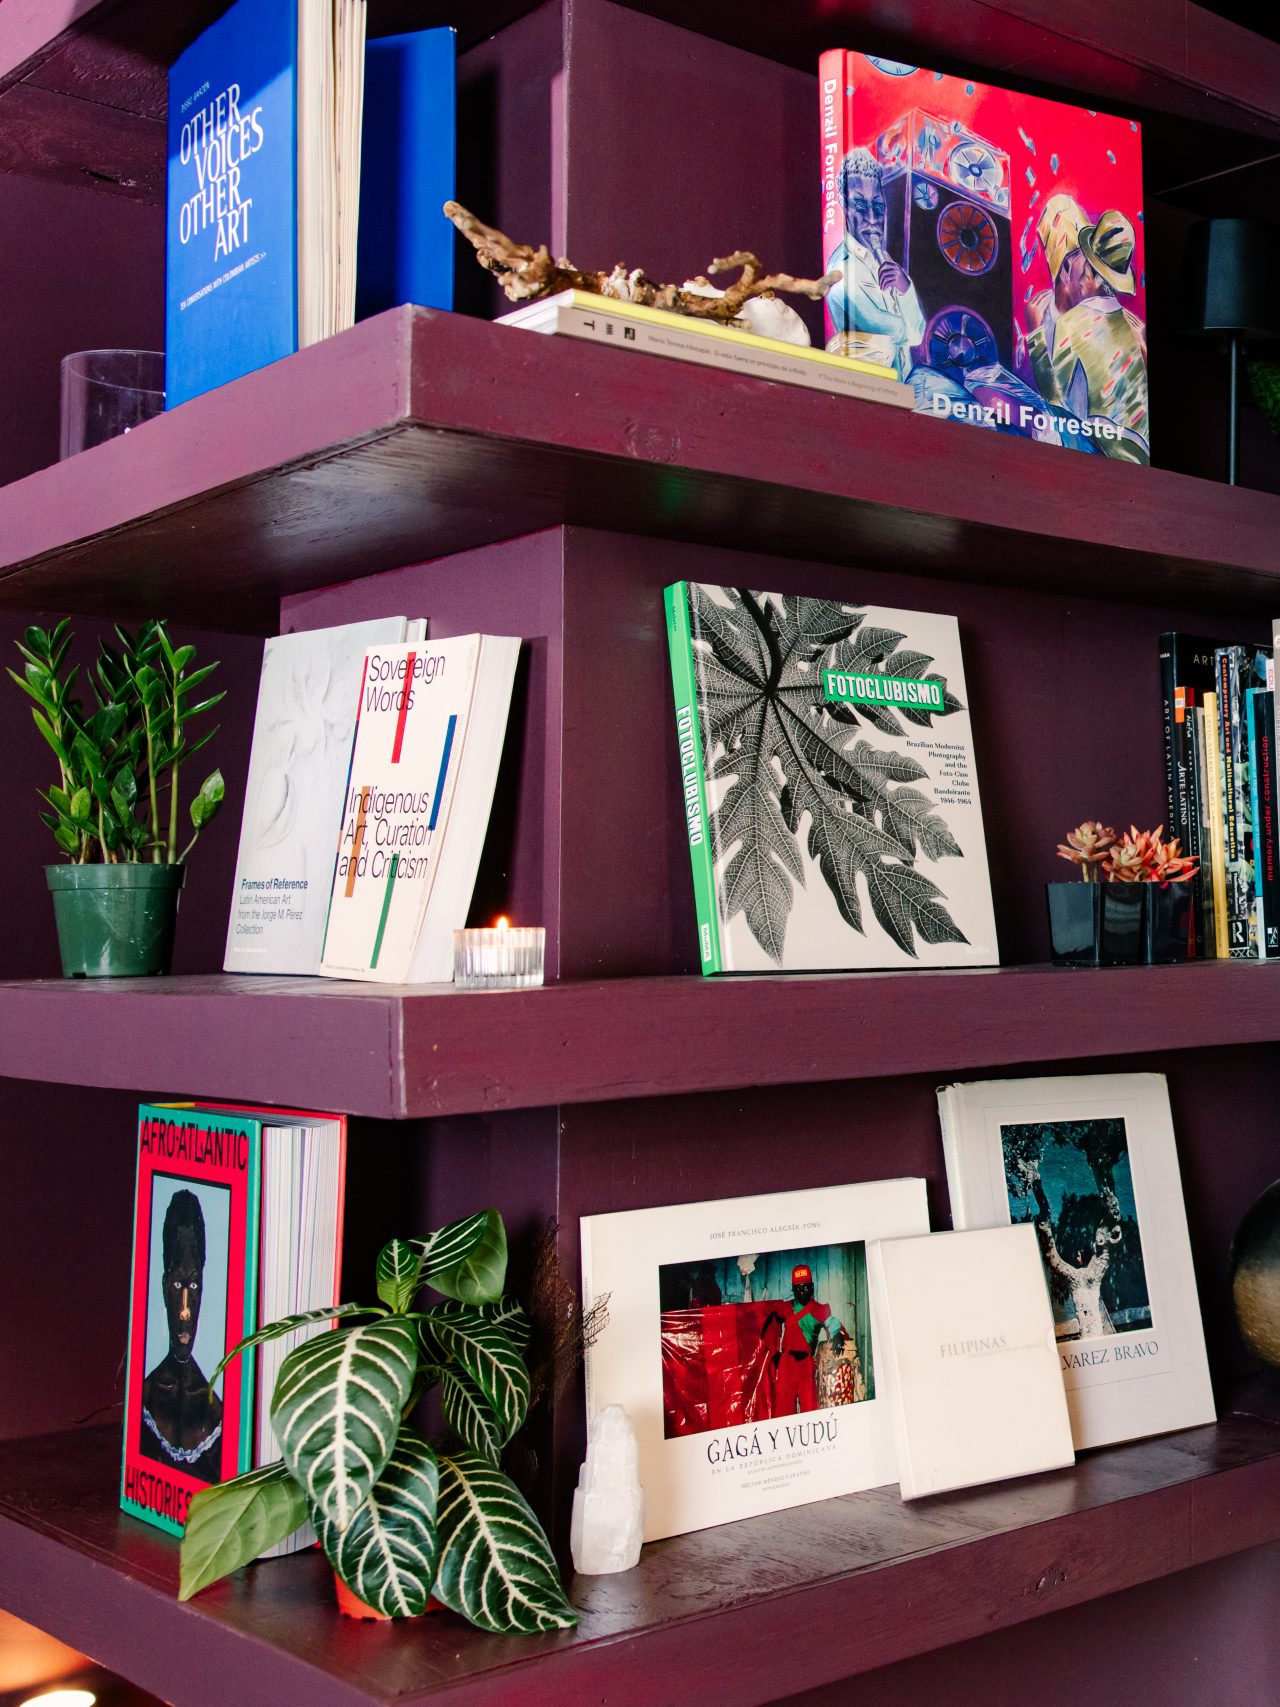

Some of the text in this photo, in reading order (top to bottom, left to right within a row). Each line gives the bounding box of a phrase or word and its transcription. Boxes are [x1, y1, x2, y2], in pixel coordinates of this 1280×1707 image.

[180, 83, 241, 166] OTHER
[194, 106, 265, 191] VOICES
[822, 78, 838, 227] Denzil Forrester
[179, 166, 241, 246] OTHER
[213, 198, 253, 263] ART
[932, 391, 1126, 442] Denzil Forrester
[368, 650, 446, 685] Sovereign
[365, 685, 417, 713] Words
[826, 673, 941, 706] FOTOCLUBISMO
[906, 740, 965, 751] Brazilian Modernist
[1164, 725, 1171, 743] OF
[928, 751, 967, 761] Photography
[1165, 746, 1173, 781] LATIN
[675, 704, 705, 848] FOTOCLUBISMO
[1177, 760, 1188, 826] ARTE LATINO
[348, 786, 430, 821] Indigenous
[1262, 734, 1275, 882] memory under construction
[343, 817, 434, 851] Art, Curation
[338, 849, 429, 879] and Criticism
[241, 877, 309, 891] Frames of Reference
[940, 1335, 1007, 1358] FILIPINAS
[1062, 1349, 1110, 1371] VAREZ
[1114, 1341, 1159, 1361] BRAVO
[707, 1412, 838, 1465] GAGÁ Y VUDÚ
